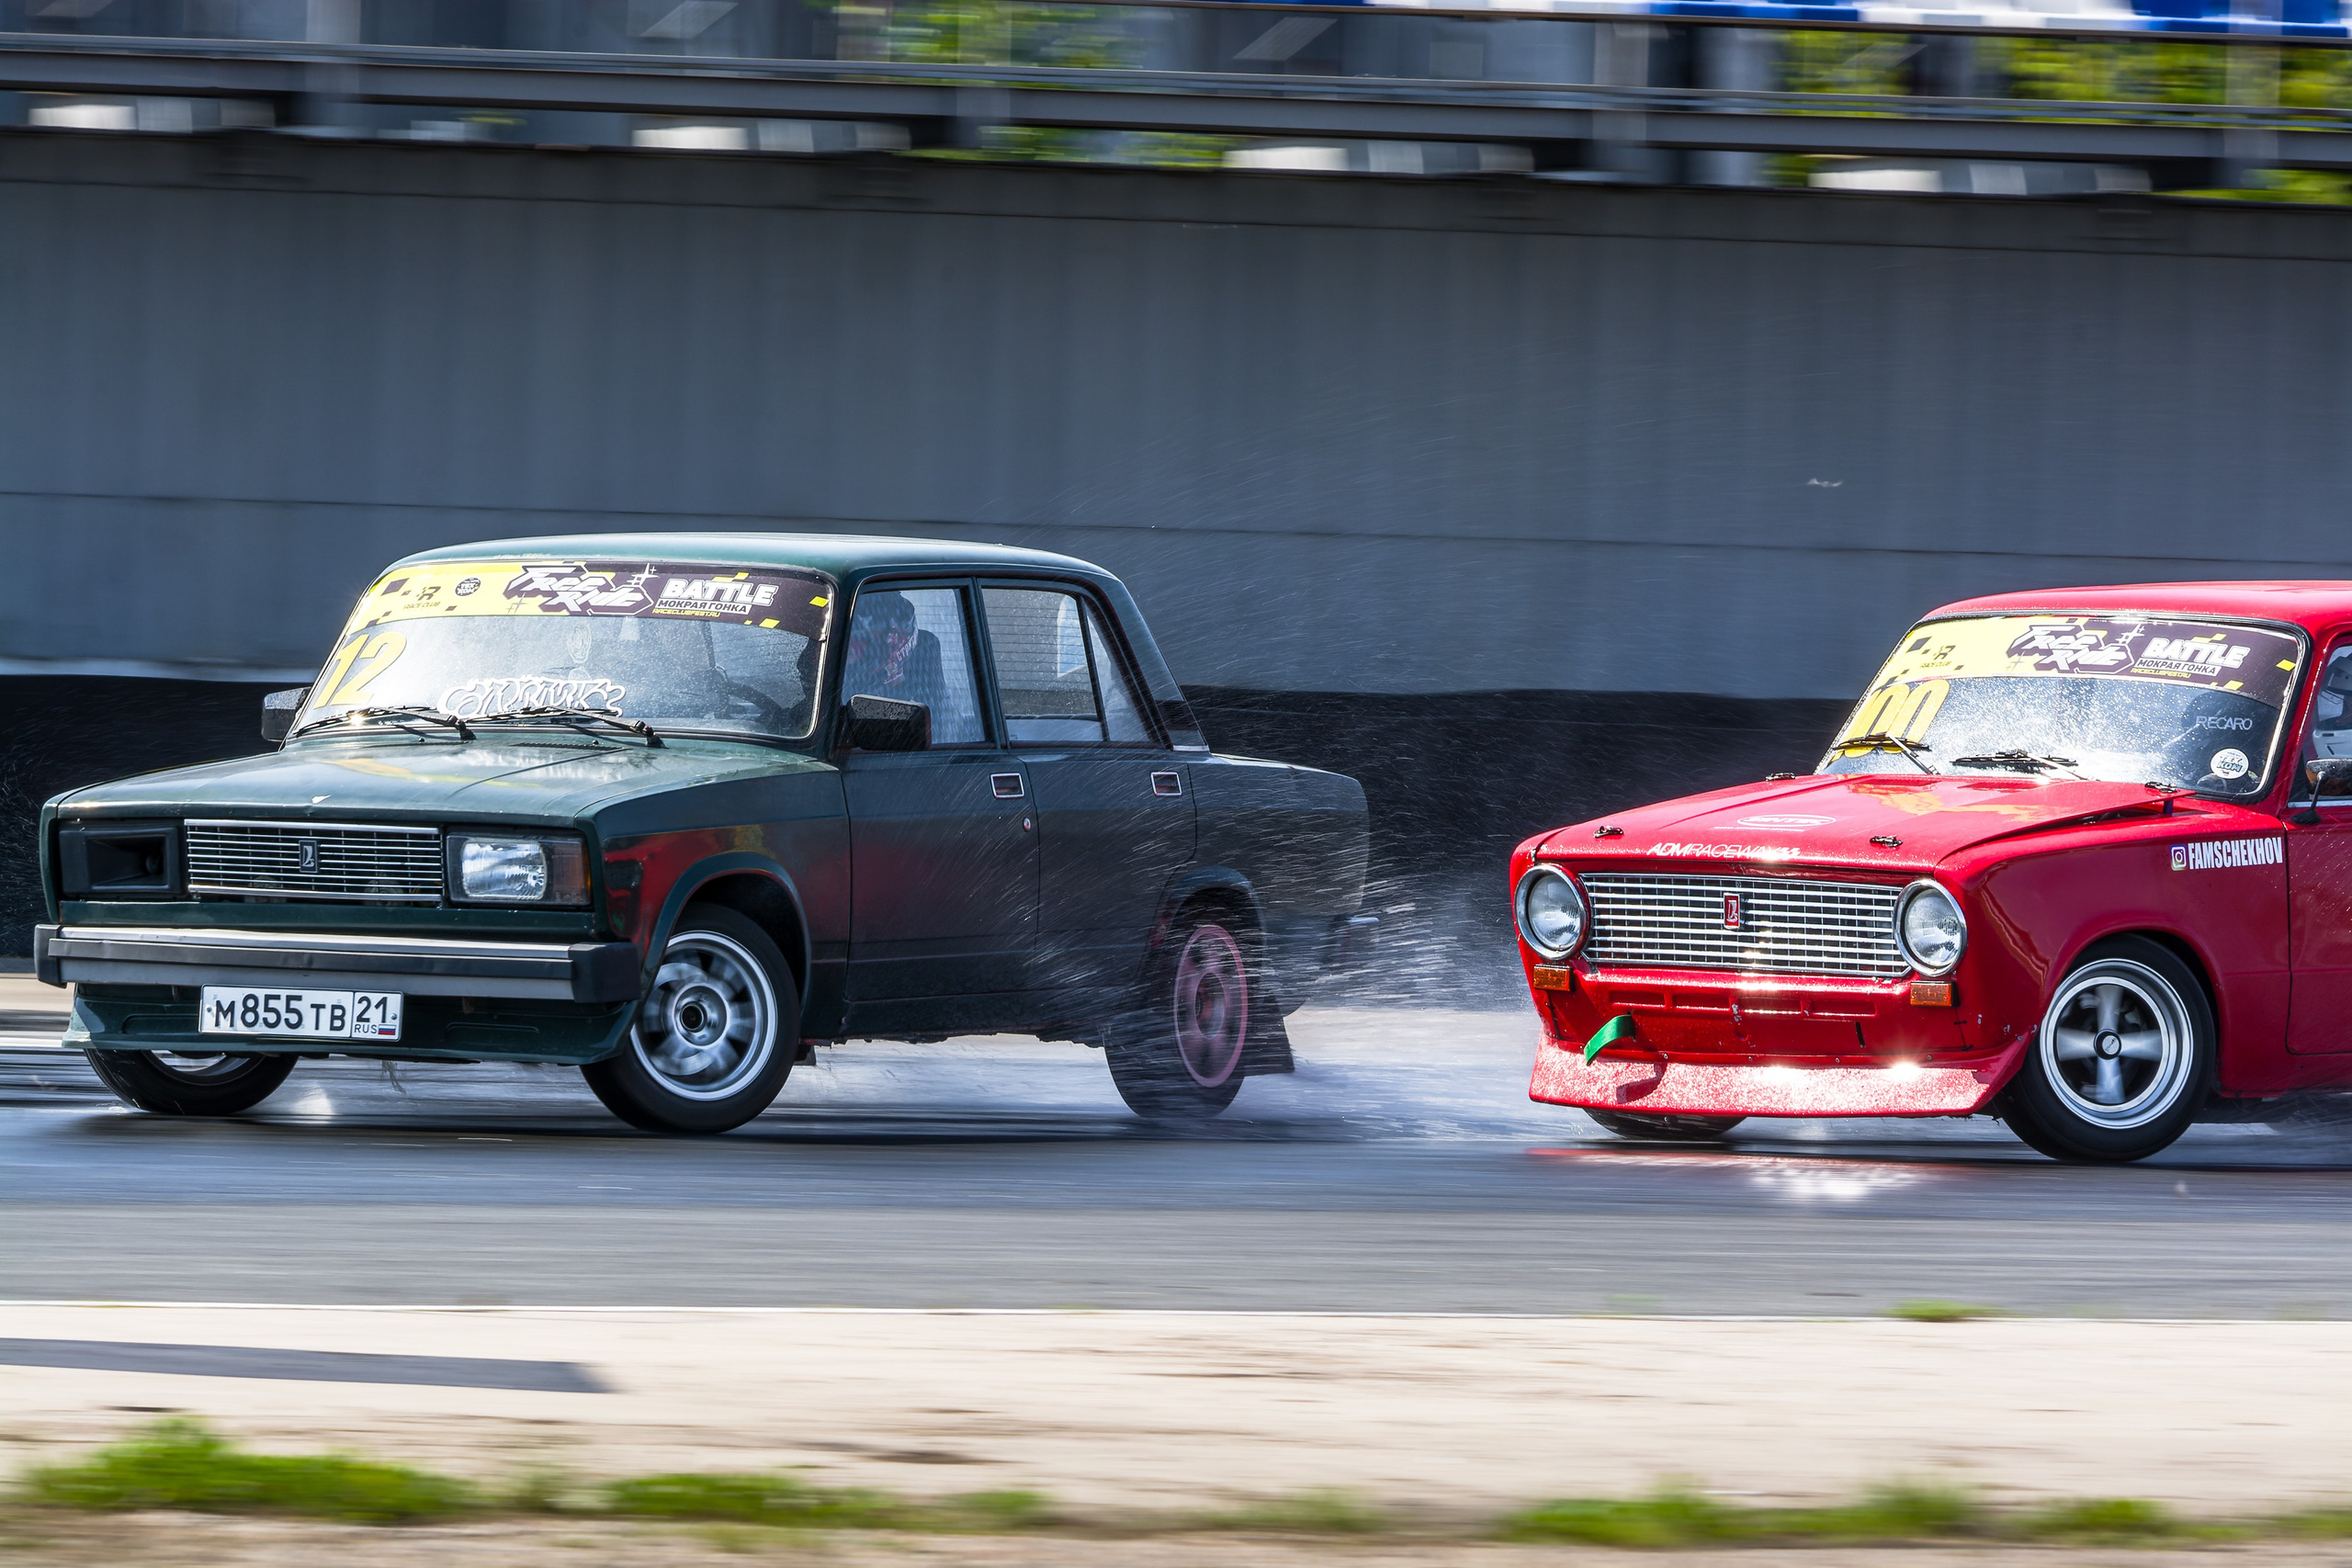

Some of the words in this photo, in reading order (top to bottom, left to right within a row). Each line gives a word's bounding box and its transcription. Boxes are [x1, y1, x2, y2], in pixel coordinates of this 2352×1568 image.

[660, 578, 779, 606] BATTLE
[657, 600, 707, 609] МОКРАЯ
[707, 603, 747, 613] ГОНКА
[2137, 659, 2181, 670] МОКРАЯ
[2181, 663, 2217, 674] ГОНКА
[2141, 637, 2251, 669] BATTLE
[312, 631, 407, 710] 12
[2196, 716, 2253, 730] RECARO
[2188, 837, 2283, 870] FAMSCHEKHOV
[356, 996, 389, 1023] 21
[354, 1023, 378, 1034] RUS
